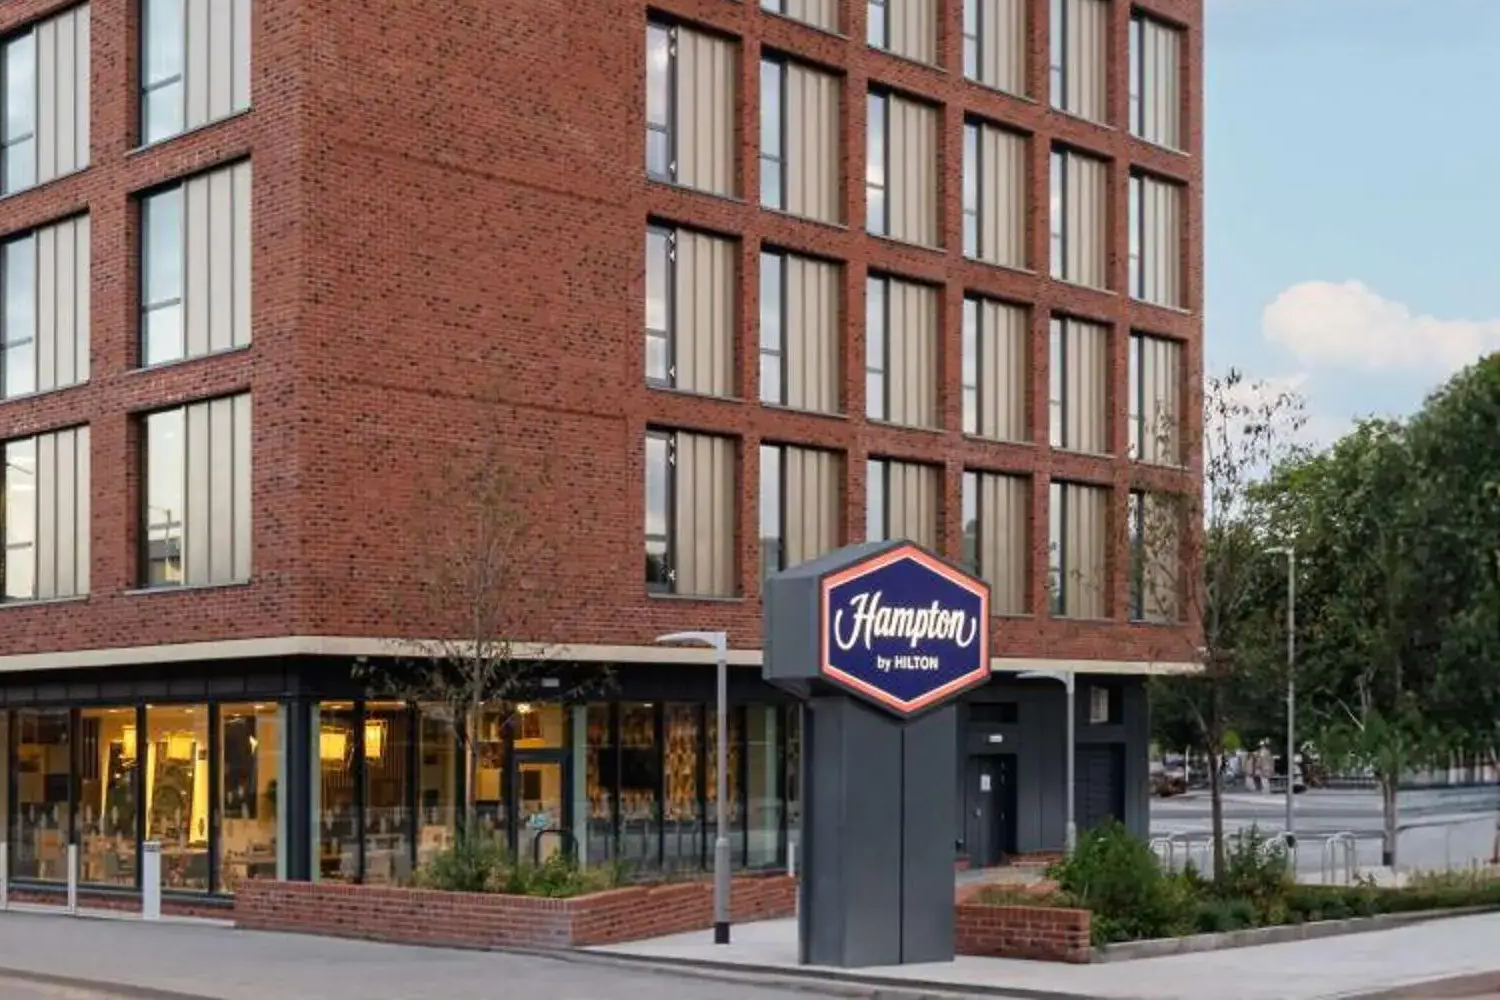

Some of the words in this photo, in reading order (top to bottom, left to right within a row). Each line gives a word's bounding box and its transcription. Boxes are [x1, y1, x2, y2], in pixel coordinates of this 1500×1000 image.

[834, 590, 977, 650] Hampton
[877, 655, 891, 672] by
[894, 656, 939, 670] HILTON
